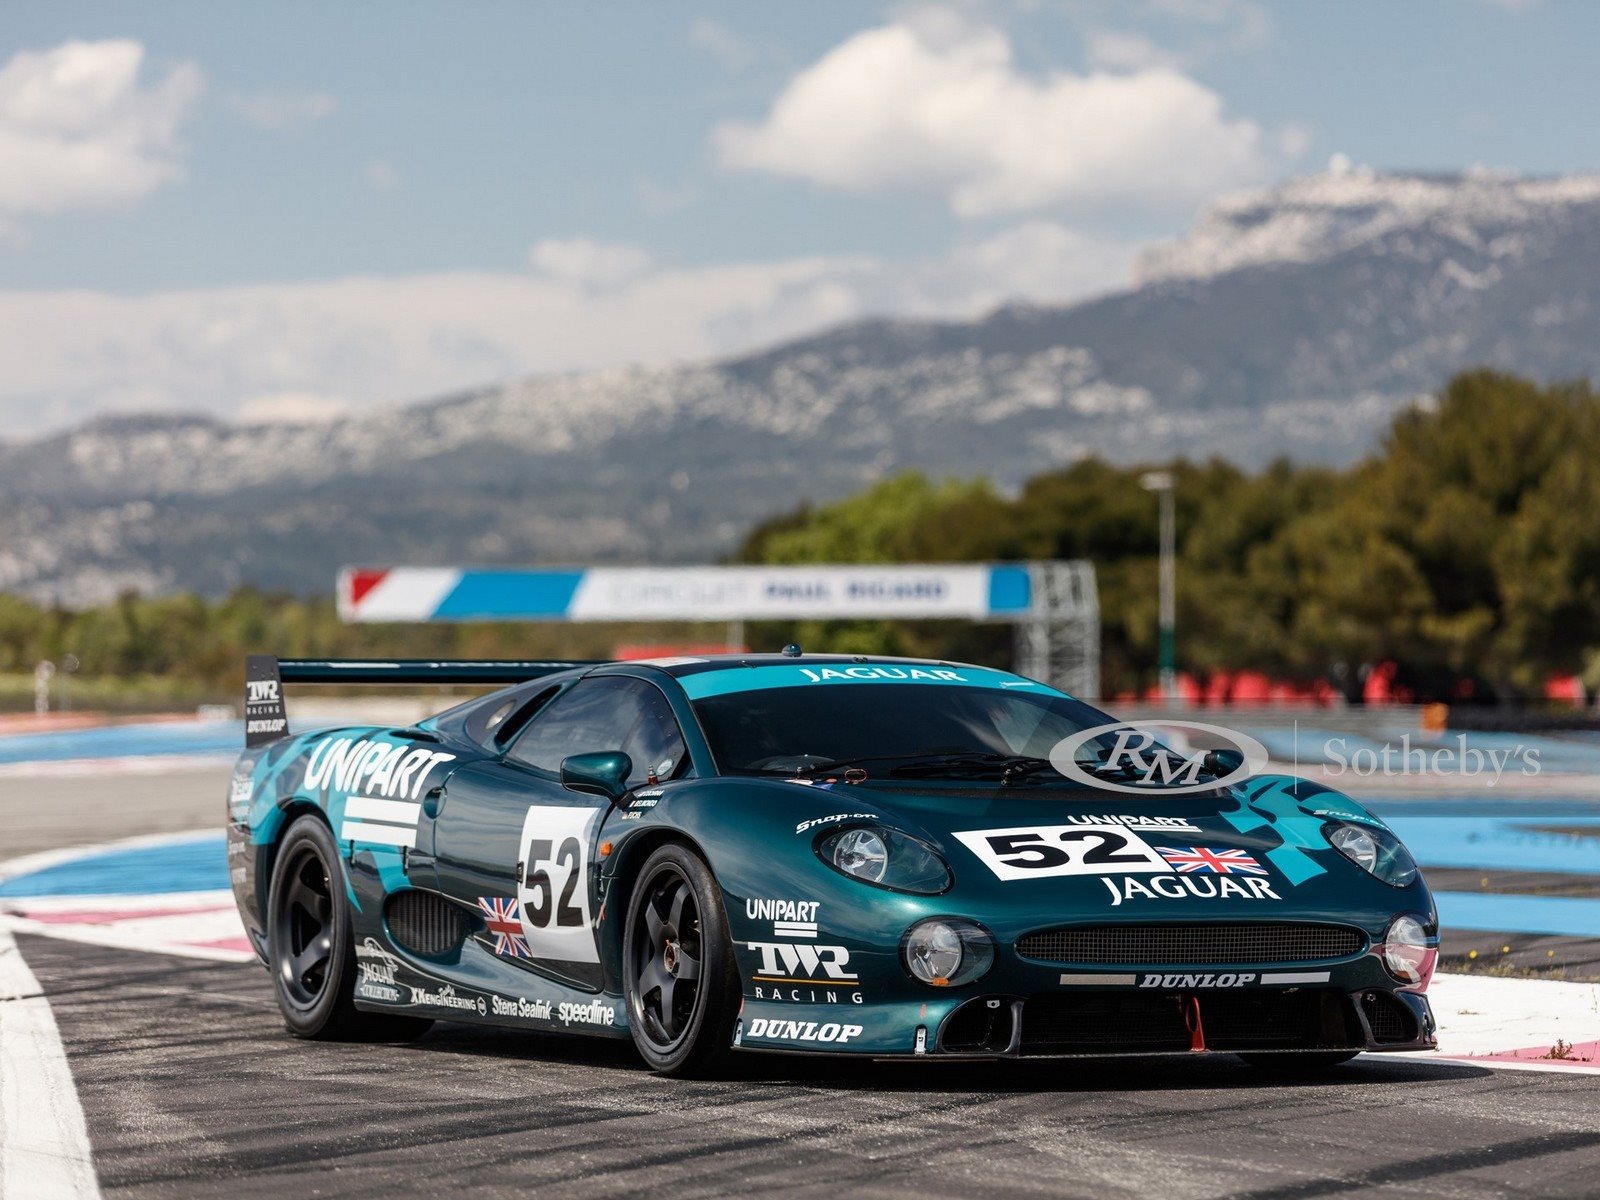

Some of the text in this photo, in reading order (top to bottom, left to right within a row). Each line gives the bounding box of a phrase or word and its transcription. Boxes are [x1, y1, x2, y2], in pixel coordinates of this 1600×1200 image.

[800, 667, 968, 683] JAGUAR
[246, 680, 280, 700] TWR
[246, 705, 280, 715] RACING
[247, 719, 286, 733] DUNLOP
[303, 737, 456, 800] UNIPART
[796, 812, 880, 834] Snap-on
[1067, 814, 1189, 827] UNIPART
[985, 830, 1152, 869] 52
[523, 836, 585, 929] 52
[1100, 875, 1283, 906] JAGUAR
[746, 898, 820, 922] UNIPART
[747, 942, 858, 979] TWR
[1139, 973, 1256, 988] DUNLOP
[492, 995, 552, 1019] Stena Sealink
[755, 987, 863, 1004] RACING
[558, 1000, 615, 1026] speedline
[747, 1018, 864, 1043] DUNLOP
